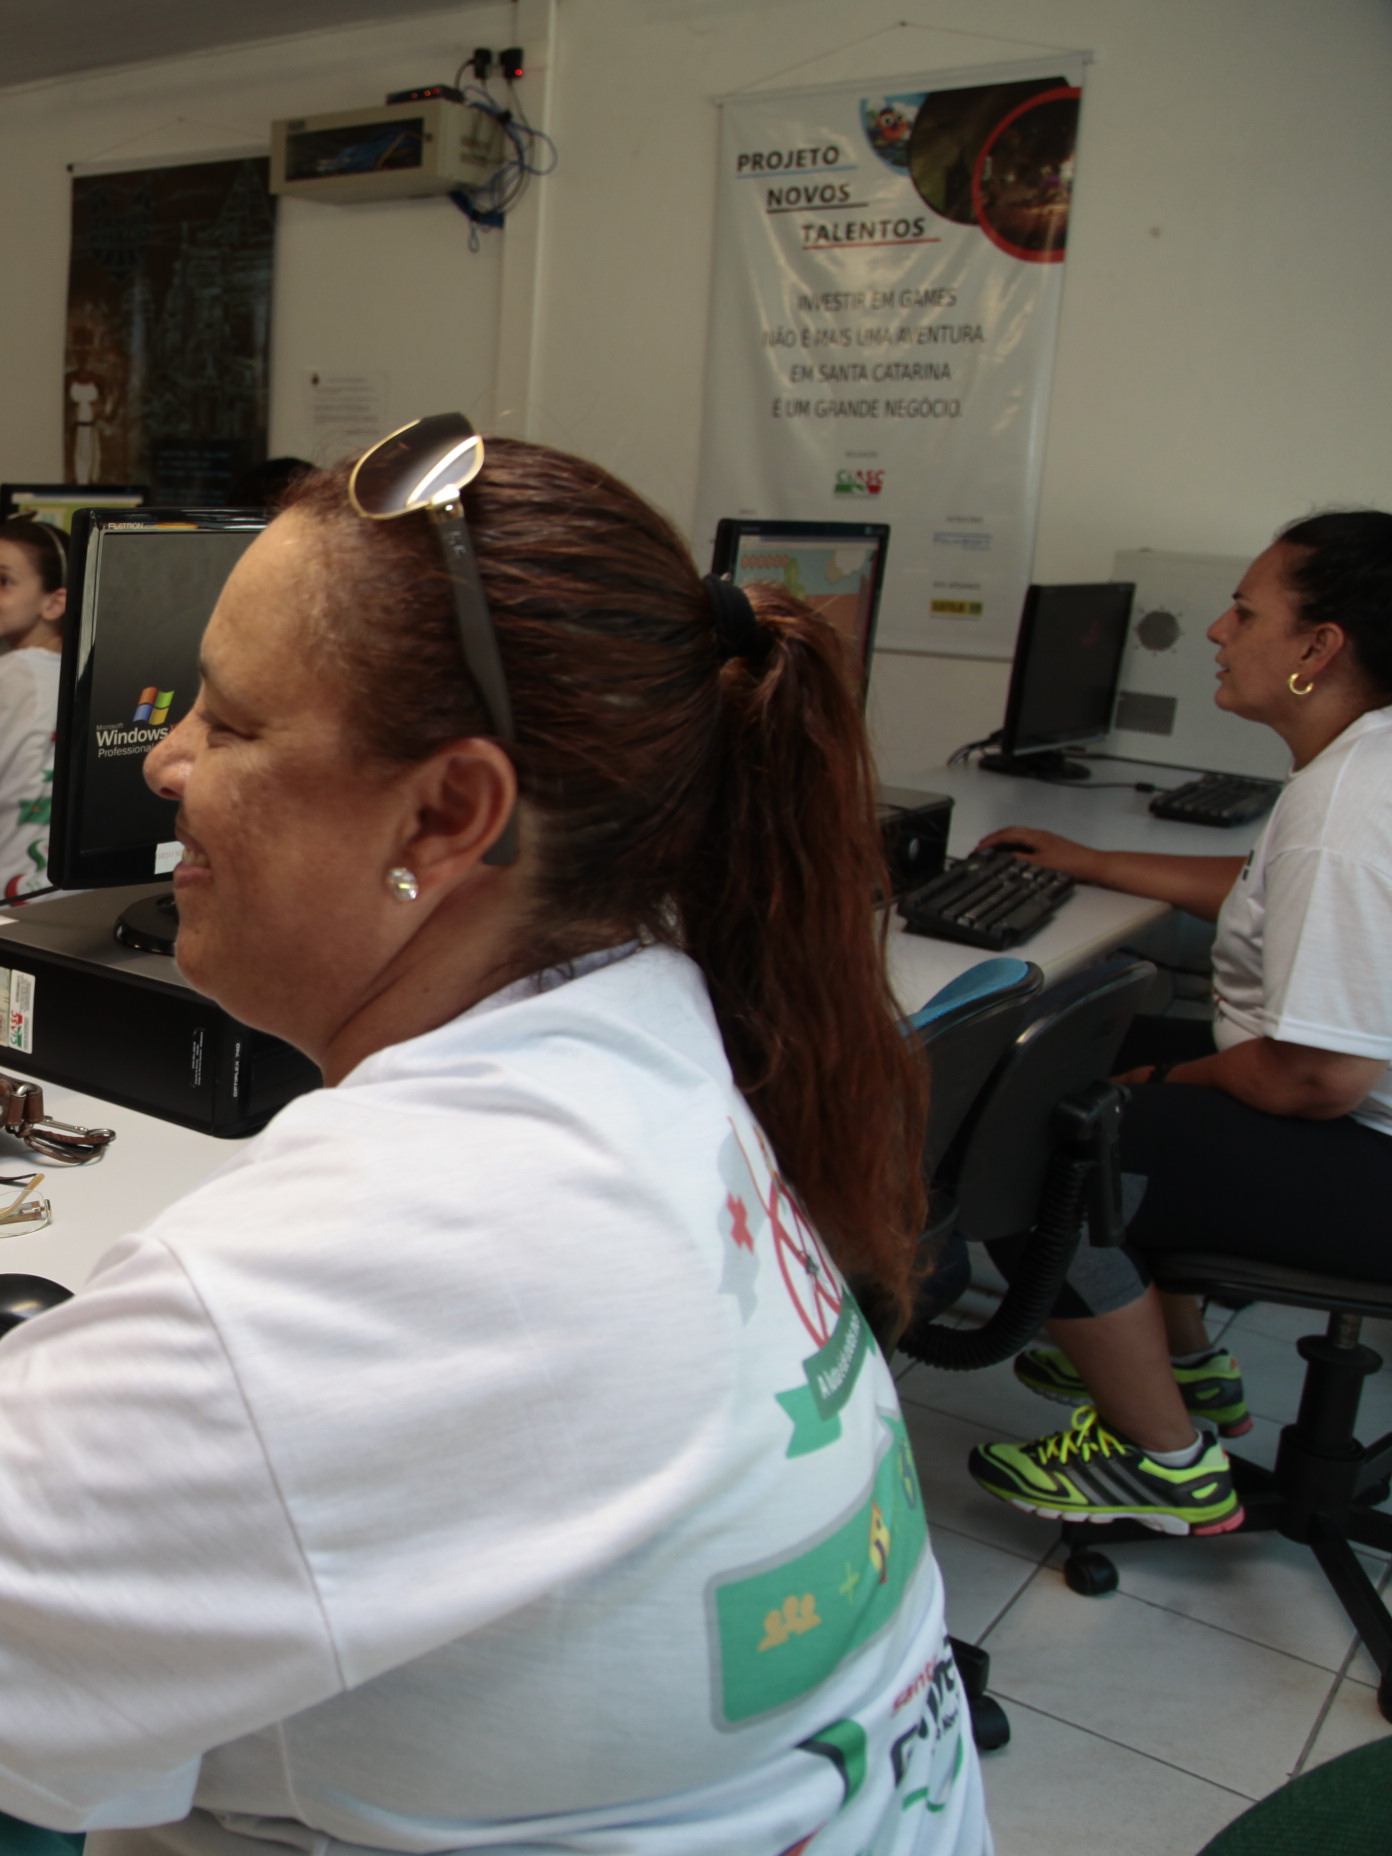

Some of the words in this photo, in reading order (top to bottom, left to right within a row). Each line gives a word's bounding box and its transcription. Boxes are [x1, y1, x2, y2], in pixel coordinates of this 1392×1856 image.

[737, 146, 840, 172] PROJETO
[766, 183, 851, 206] NOVOS
[802, 217, 926, 242] TALENTOS
[797, 292, 865, 312] INVESTIR
[872, 290, 895, 310] EM
[899, 288, 957, 308] GAMES
[790, 364, 814, 383] EM
[819, 363, 868, 383] SANTA
[872, 362, 952, 382] CATARINA
[786, 399, 811, 418] UM
[815, 399, 880, 418] GRANDE
[108, 522, 144, 530] FLATRON
[96, 722, 123, 731] Microsoft
[96, 727, 169, 748] Windows
[98, 743, 154, 758] Professional
